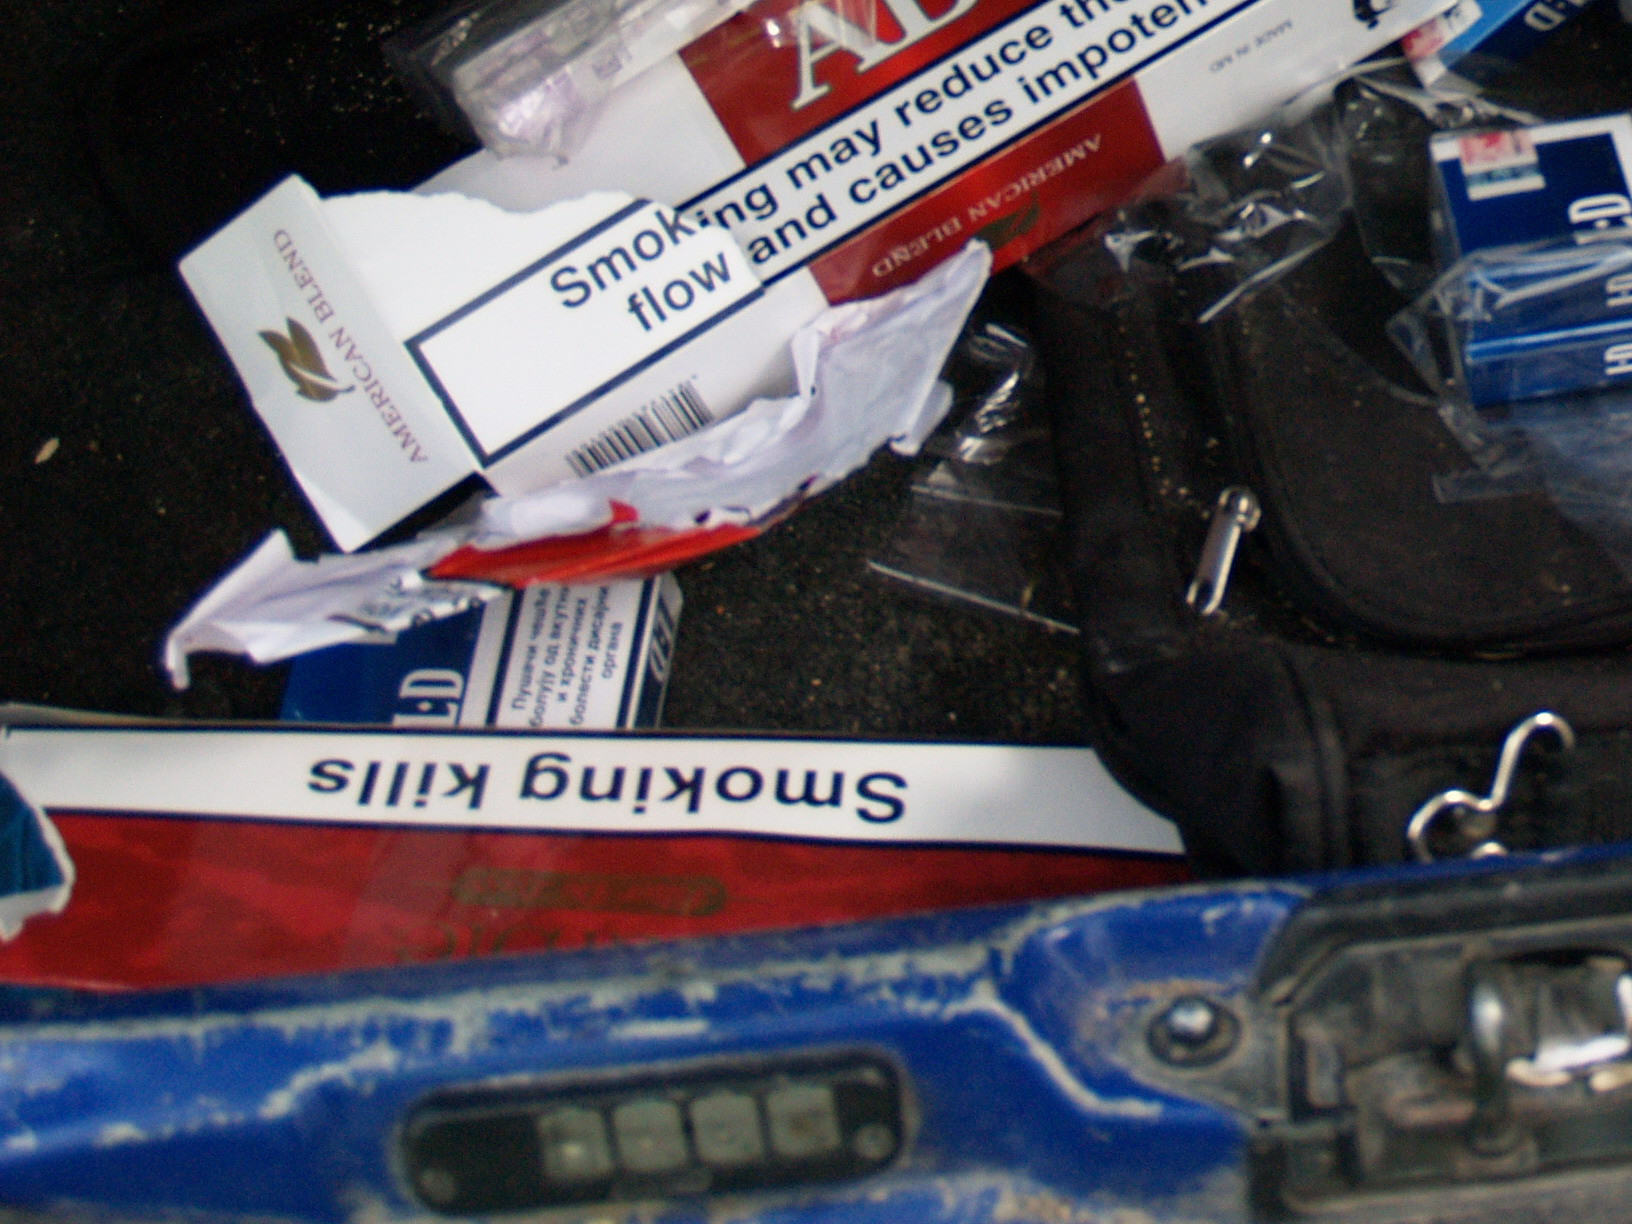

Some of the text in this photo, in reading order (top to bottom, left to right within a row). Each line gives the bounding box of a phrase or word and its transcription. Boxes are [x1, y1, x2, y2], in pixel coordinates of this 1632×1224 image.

[549, 171, 778, 312] Smoking
[789, 114, 885, 192] may
[894, 17, 1055, 127] reduce
[625, 252, 735, 333] flow
[749, 195, 839, 266] and
[848, 97, 1015, 209] causes
[871, 132, 1104, 280] AMERICAN BLEND
[272, 228, 430, 465] AMERICAN BLEND
[601, 621, 623, 678] органа
[306, 750, 911, 826] Smoking kills
